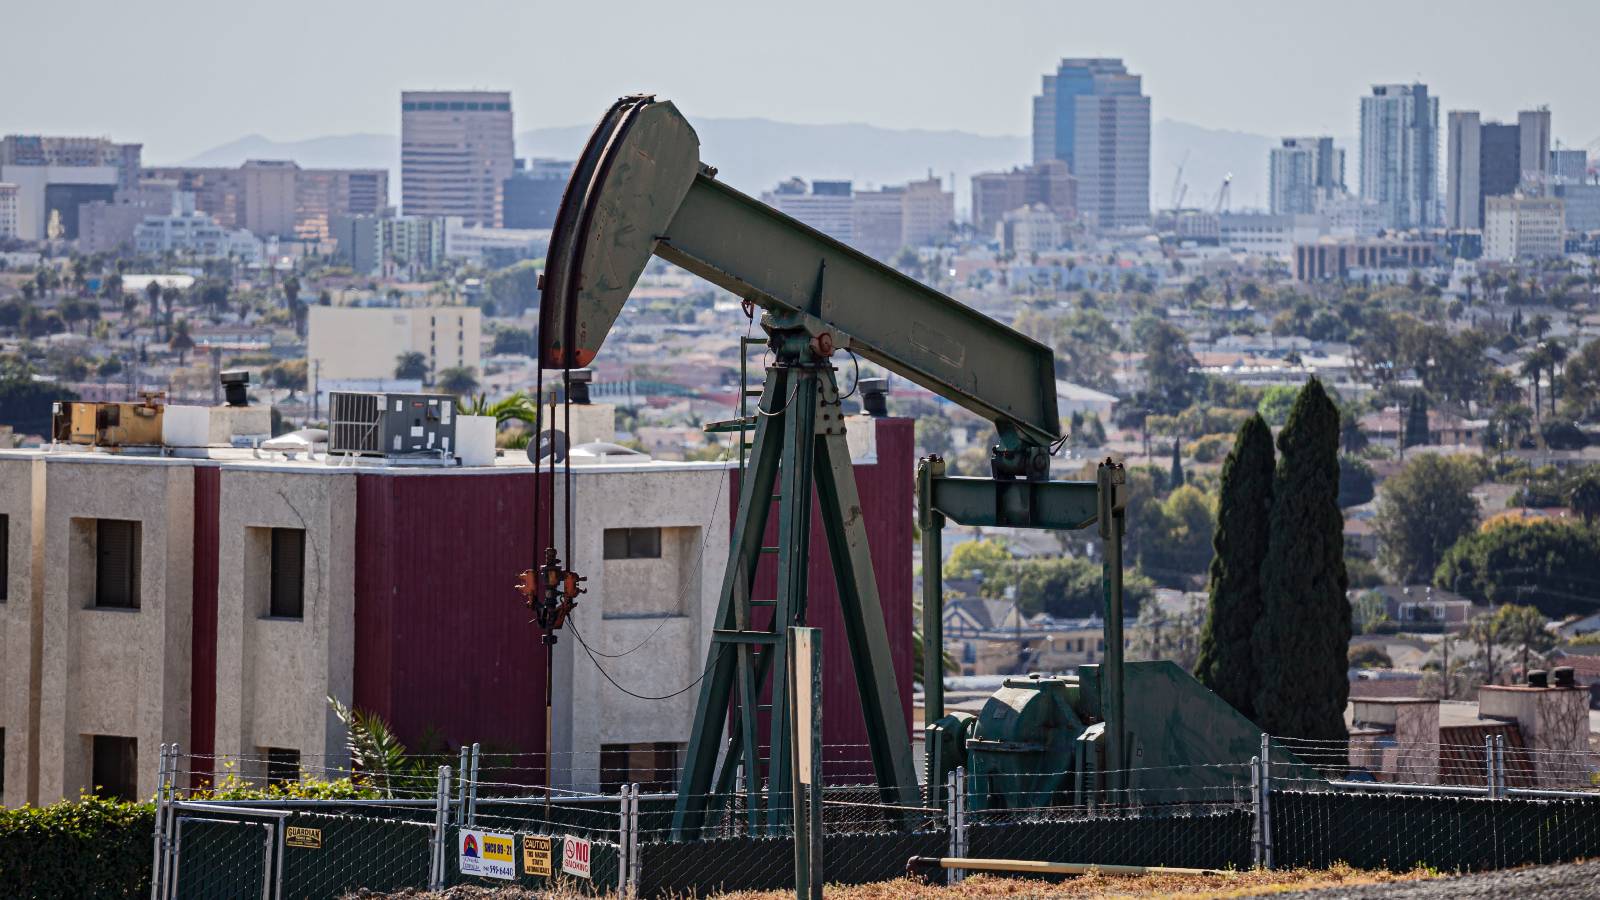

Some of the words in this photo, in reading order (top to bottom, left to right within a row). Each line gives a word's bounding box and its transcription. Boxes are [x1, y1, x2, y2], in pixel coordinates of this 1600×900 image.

[288, 828, 320, 839] GUARDIAN
[525, 839, 549, 850] CAUTION
[576, 841, 588, 863] NO
[565, 859, 588, 872] SMOKING
